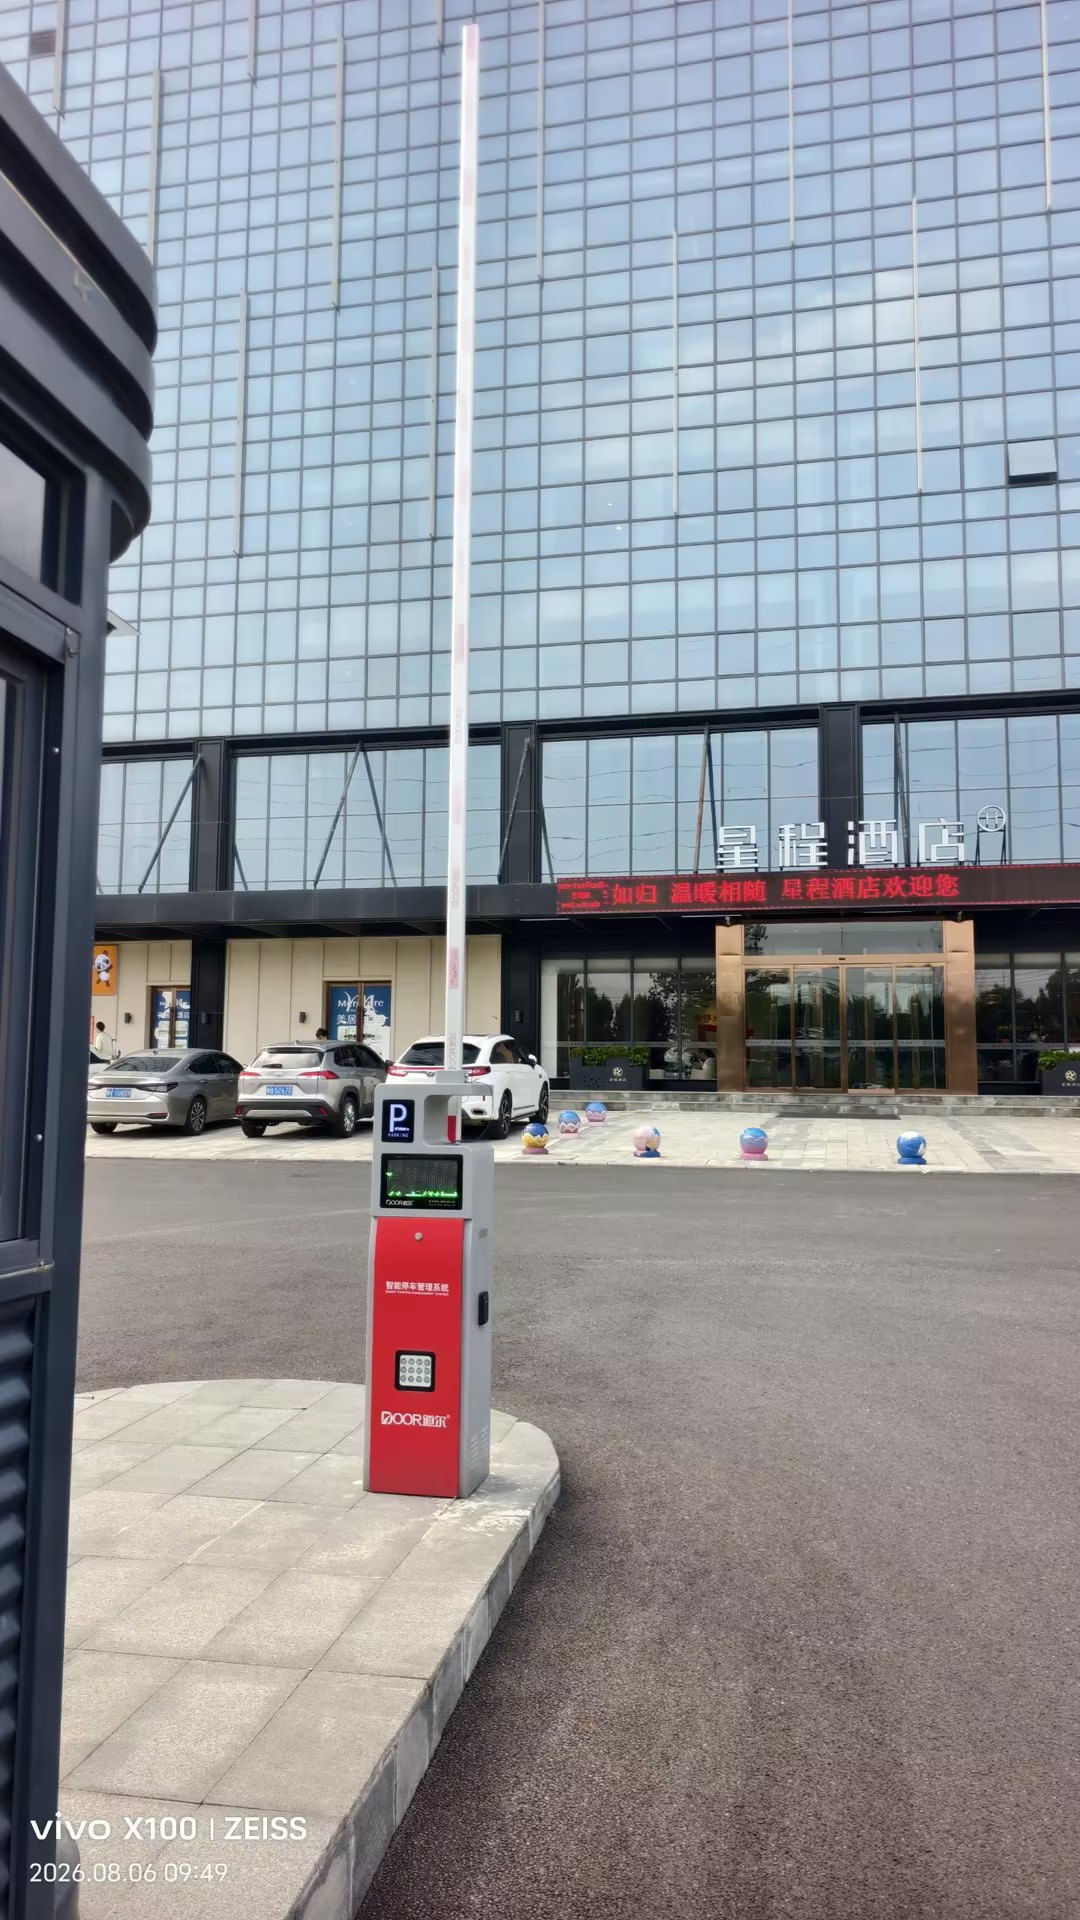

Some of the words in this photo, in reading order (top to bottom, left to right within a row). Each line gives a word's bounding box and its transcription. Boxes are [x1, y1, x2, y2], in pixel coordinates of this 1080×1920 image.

[716, 818, 964, 869] 星程酒店
[671, 880, 766, 904] 温暖相随
[782, 873, 960, 900] 星程酒店欢迎您
[389, 1103, 408, 1132] P
[385, 1281, 449, 1293] 智能停车管理系统
